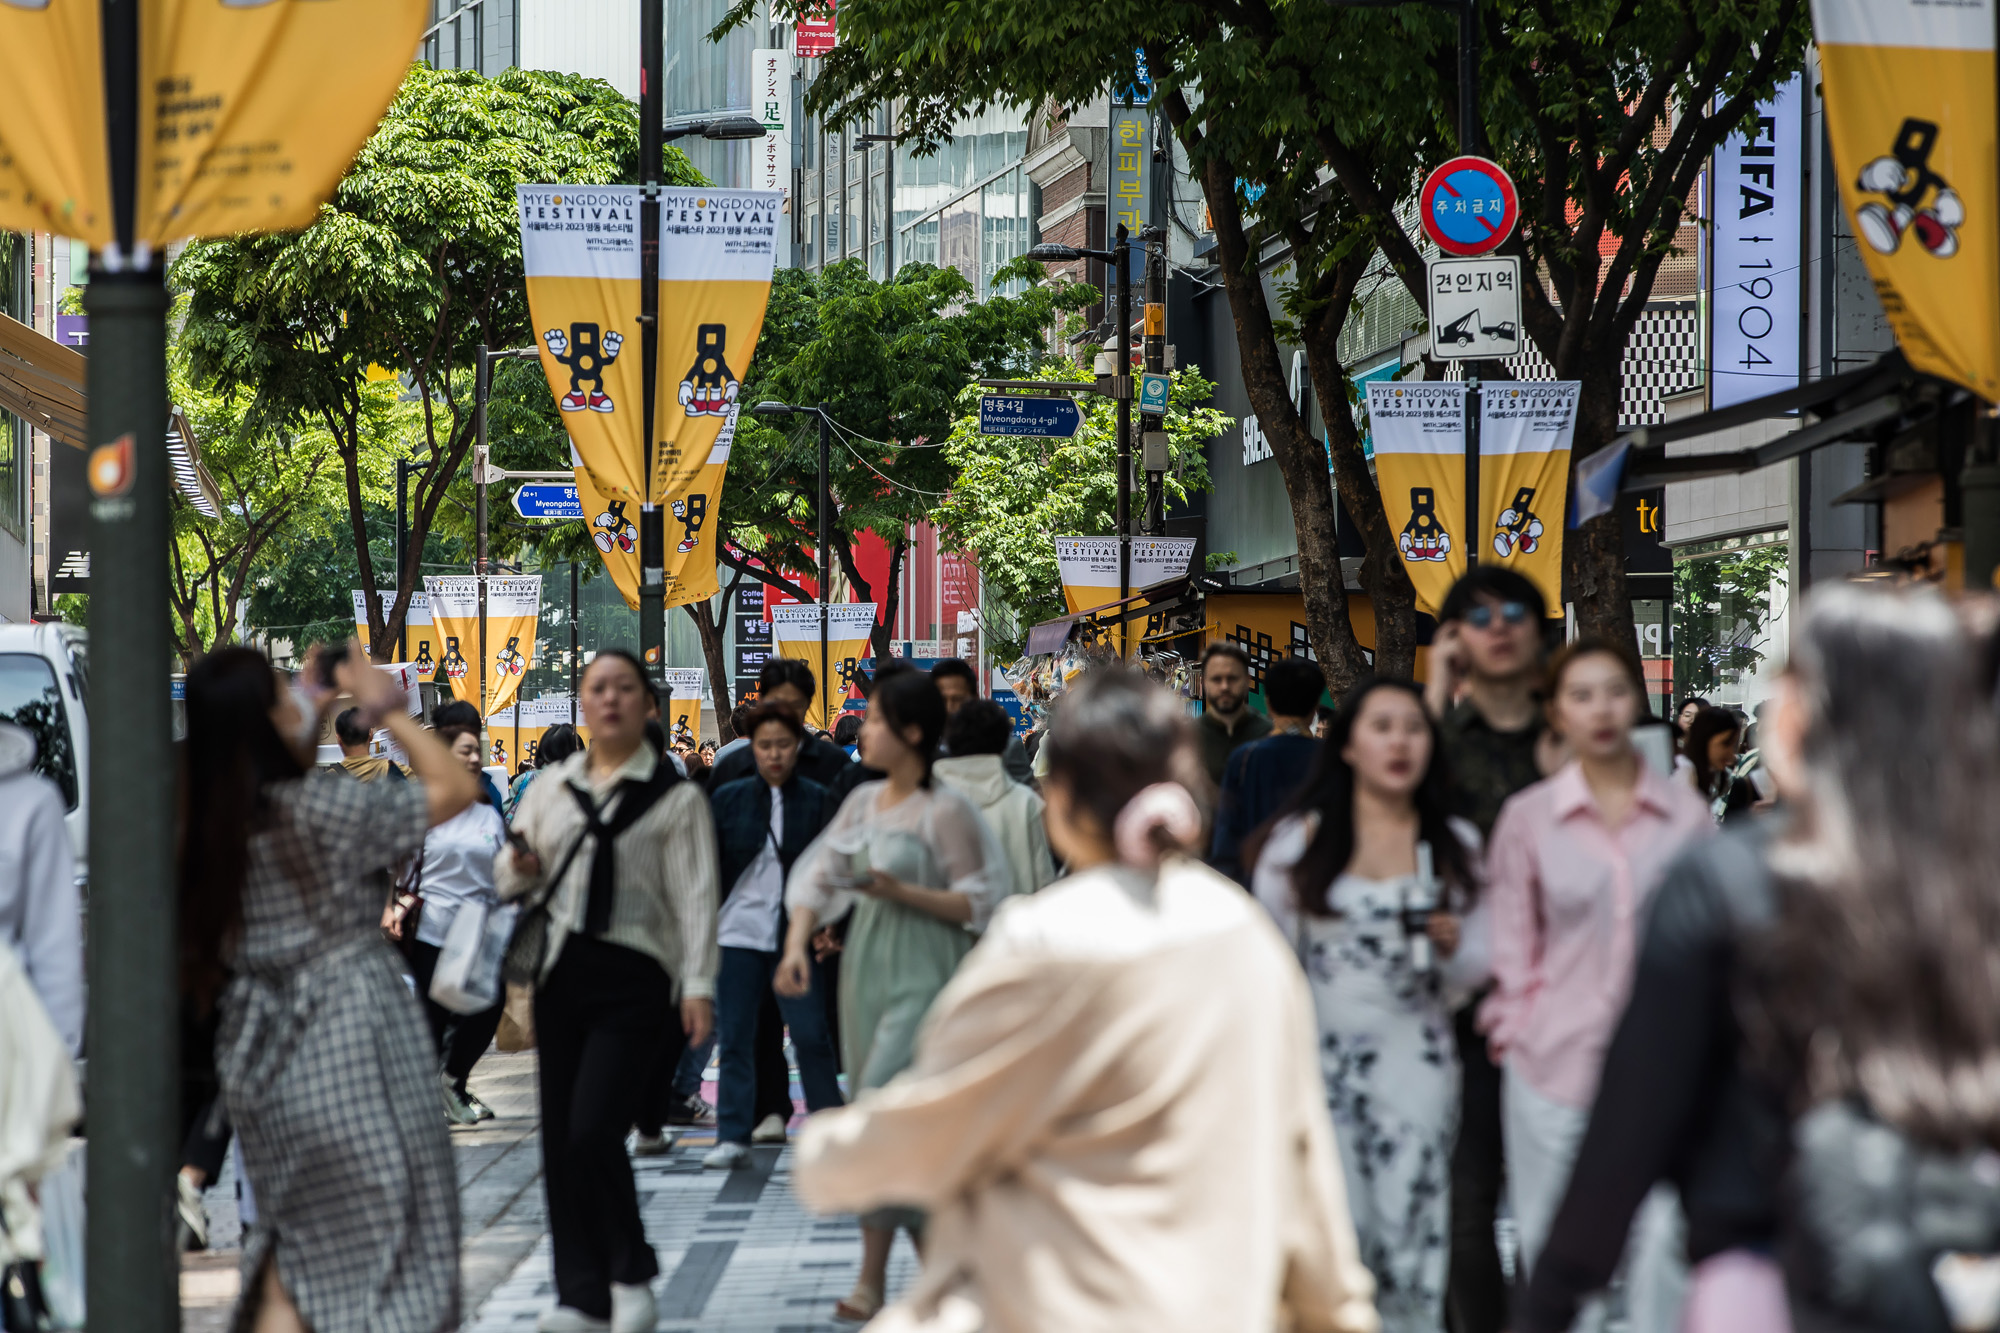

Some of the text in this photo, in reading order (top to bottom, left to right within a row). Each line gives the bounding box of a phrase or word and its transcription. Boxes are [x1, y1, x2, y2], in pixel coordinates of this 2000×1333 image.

[767, 58, 777, 97] オアシス
[764, 102, 781, 121] 足
[1116, 120, 1146, 236] 한피부과
[1436, 198, 1501, 215] 주차금지
[525, 207, 633, 220] FESTIVAL
[666, 210, 774, 223] FESTIVAL
[565, 222, 584, 231] 2023
[586, 222, 601, 232] 명동
[603, 223, 633, 233] 페스티벌
[706, 225, 725, 235] 2023
[727, 226, 742, 235] 명동
[744, 226, 773, 236] 페스티벌
[1738, 116, 1776, 370] FIFA 1904
[1436, 271, 1513, 294] 견인지역
[984, 400, 1024, 413] 명동4길
[1373, 398, 1461, 409] FESTIVAL
[1487, 398, 1572, 409] FESTIVAL
[984, 414, 1058, 426] Myeongdong 4-gil
[1405, 410, 1422, 418] 2023
[564, 488, 580, 499] 명동
[535, 500, 580, 509] Myeongdong
[744, 620, 773, 634] 방탈
